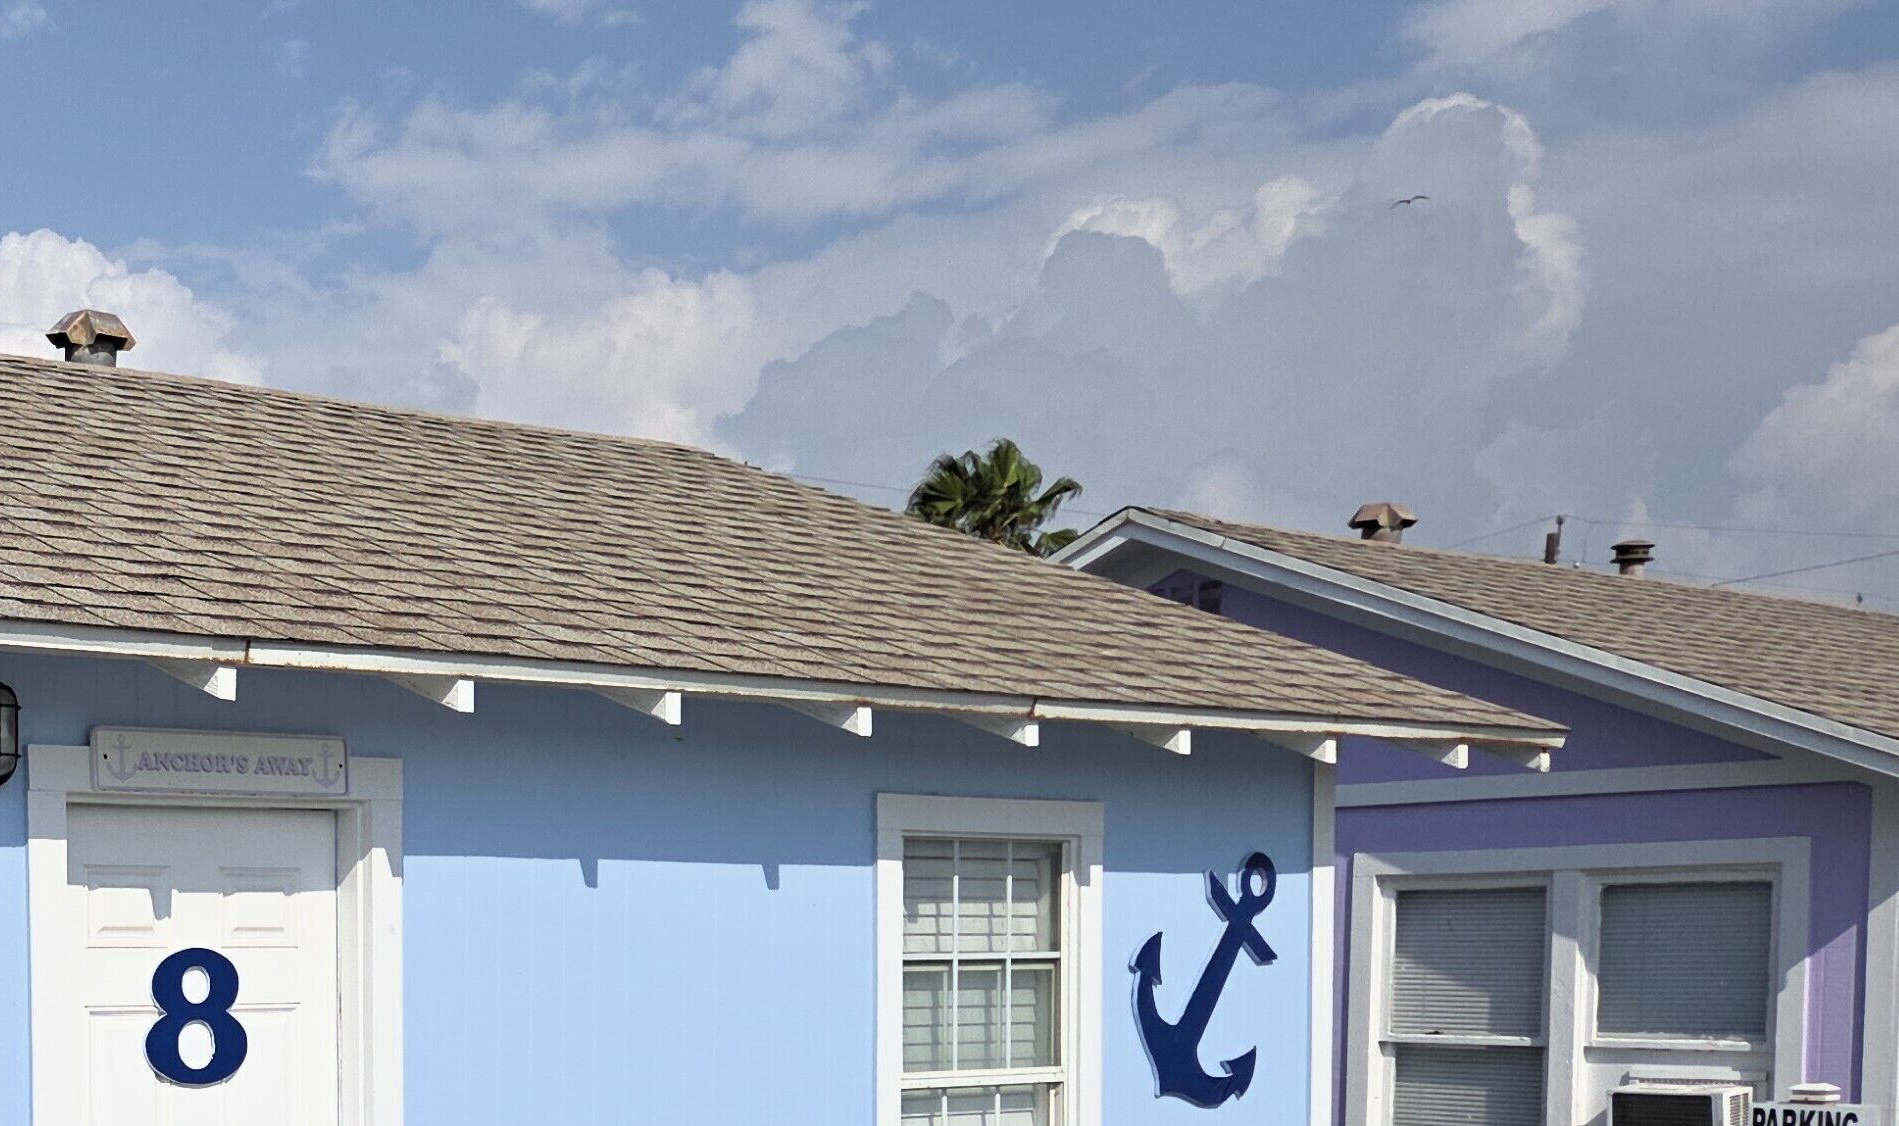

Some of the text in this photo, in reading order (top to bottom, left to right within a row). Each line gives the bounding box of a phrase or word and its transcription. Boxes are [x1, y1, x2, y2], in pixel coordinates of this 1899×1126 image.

[138, 752, 313, 776] ANCHOR'S AWAY
[145, 947, 248, 1085] 8
